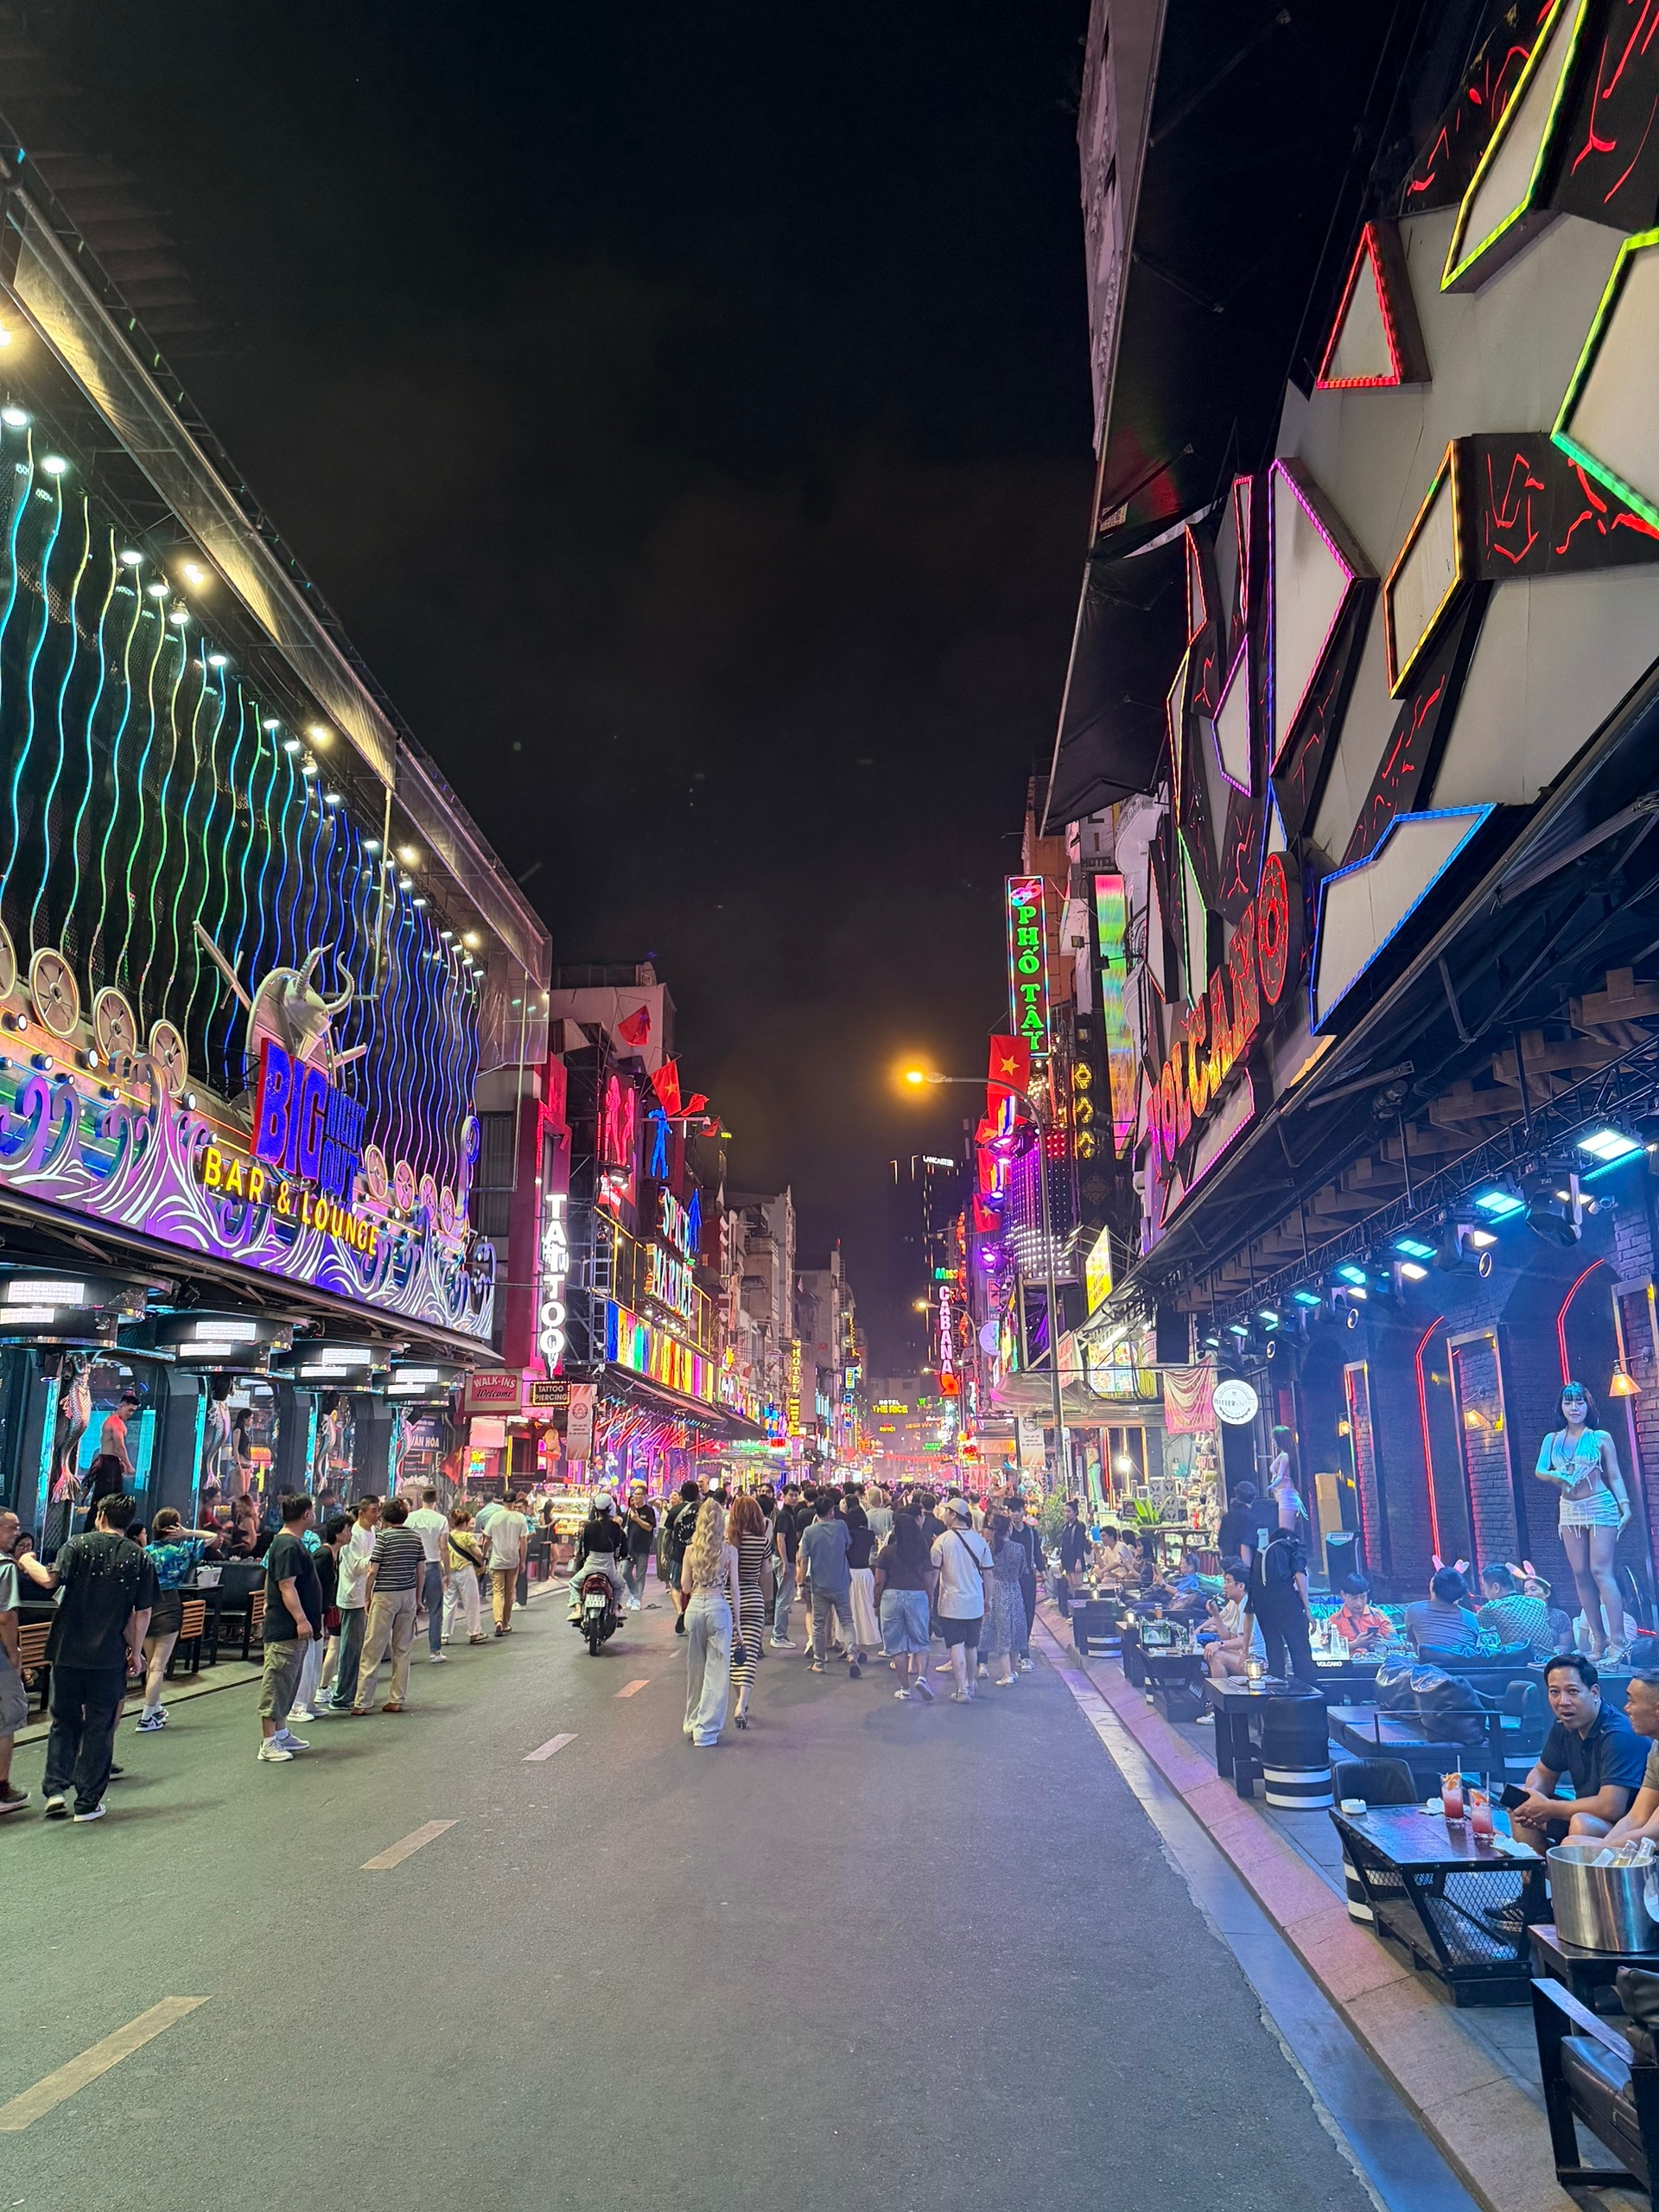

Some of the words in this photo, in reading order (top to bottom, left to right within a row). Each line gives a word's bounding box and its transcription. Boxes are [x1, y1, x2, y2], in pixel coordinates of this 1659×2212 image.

[1081, 856, 1115, 868] HOTEL
[1017, 906, 1039, 974] PHỐ
[1020, 983, 1044, 1051] TÂY
[1147, 850, 1290, 1184] VOLCANO
[255, 1039, 329, 1180] BIG
[325, 1084, 367, 1153] NIGHT
[320, 1138, 359, 1202] OUT
[922, 1154, 954, 1167] LANCASTER
[205, 1146, 264, 1205] BAR
[277, 1181, 290, 1215] &
[302, 1191, 380, 1255] LOUNGE
[539, 1193, 569, 1355] TATTOO
[938, 1285, 953, 1375] CABANA
[474, 1376, 517, 1389] WALK-INS
[476, 1389, 513, 1399] Welcome
[791, 1348, 802, 1394] HOTEL
[889, 1404, 909, 1414] RICE
